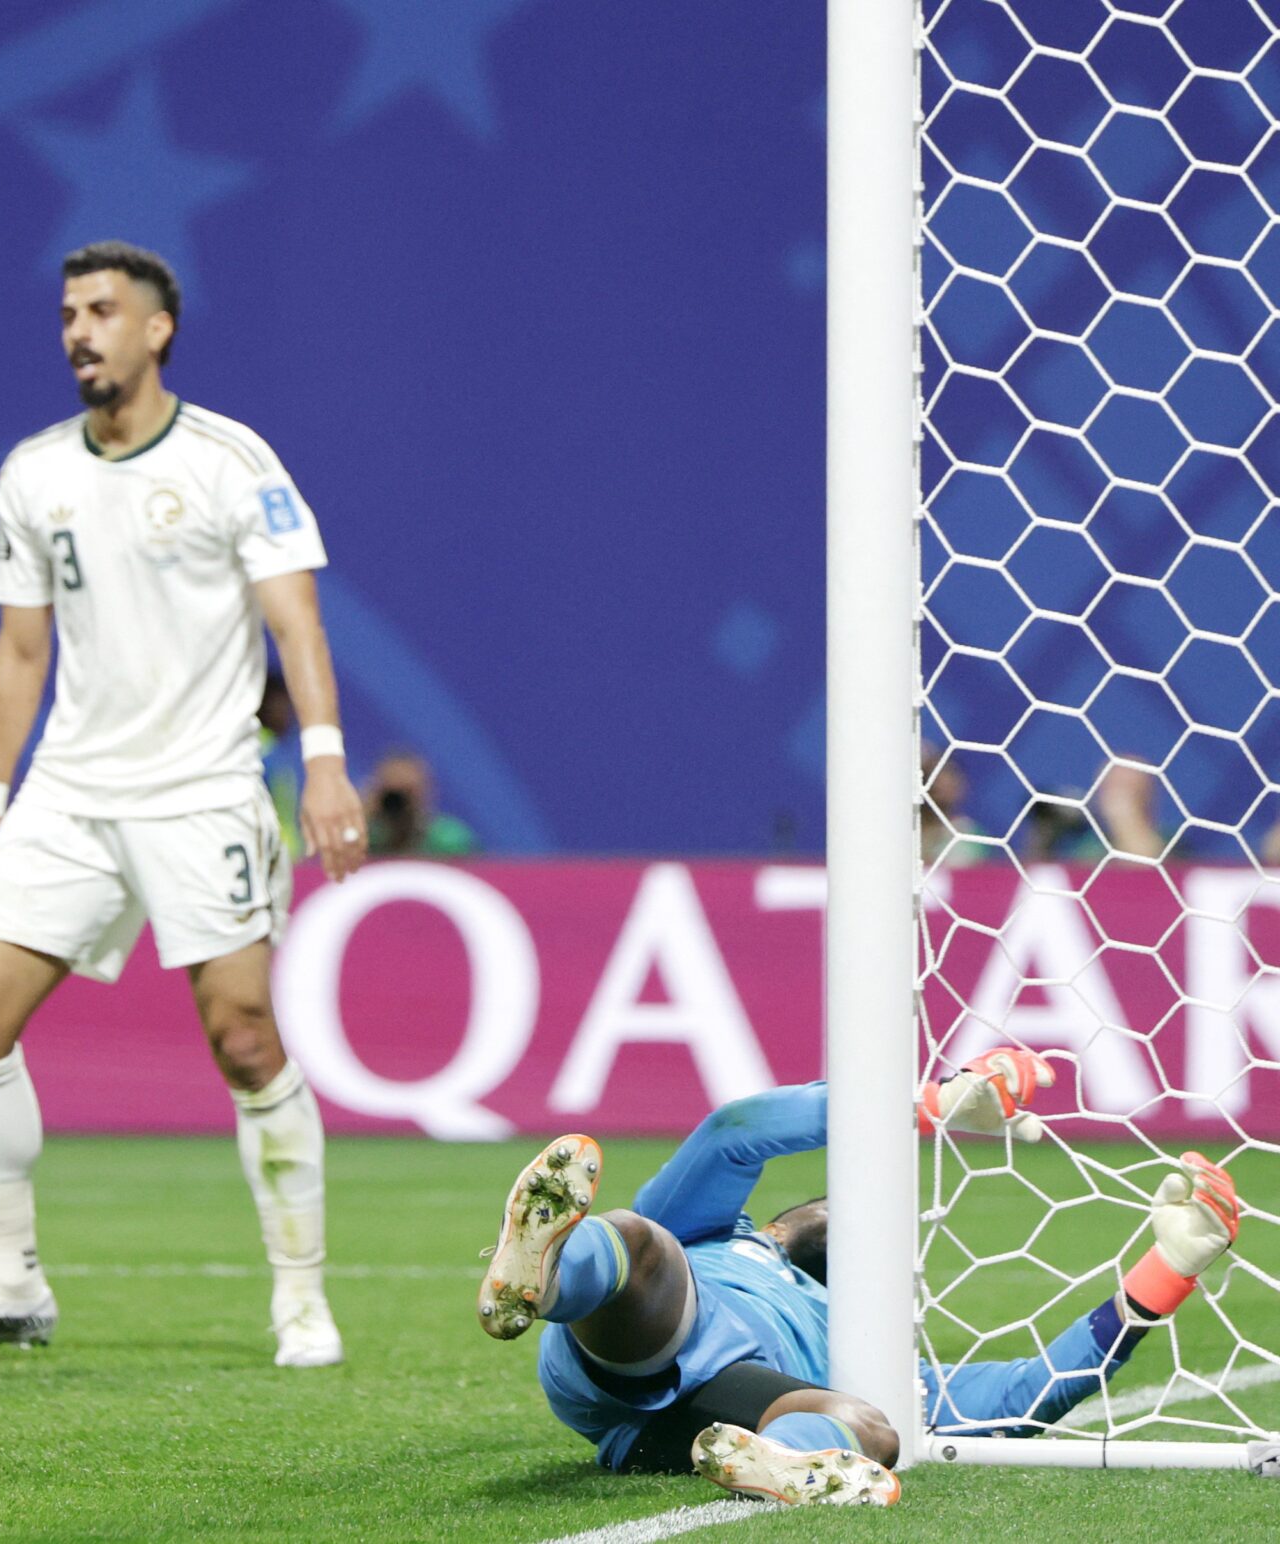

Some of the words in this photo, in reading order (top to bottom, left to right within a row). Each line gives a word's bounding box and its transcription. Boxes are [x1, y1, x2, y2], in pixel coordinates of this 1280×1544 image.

[52, 530, 83, 591] 3
[224, 844, 252, 904] 3
[275, 861, 1280, 1141] QAAR
